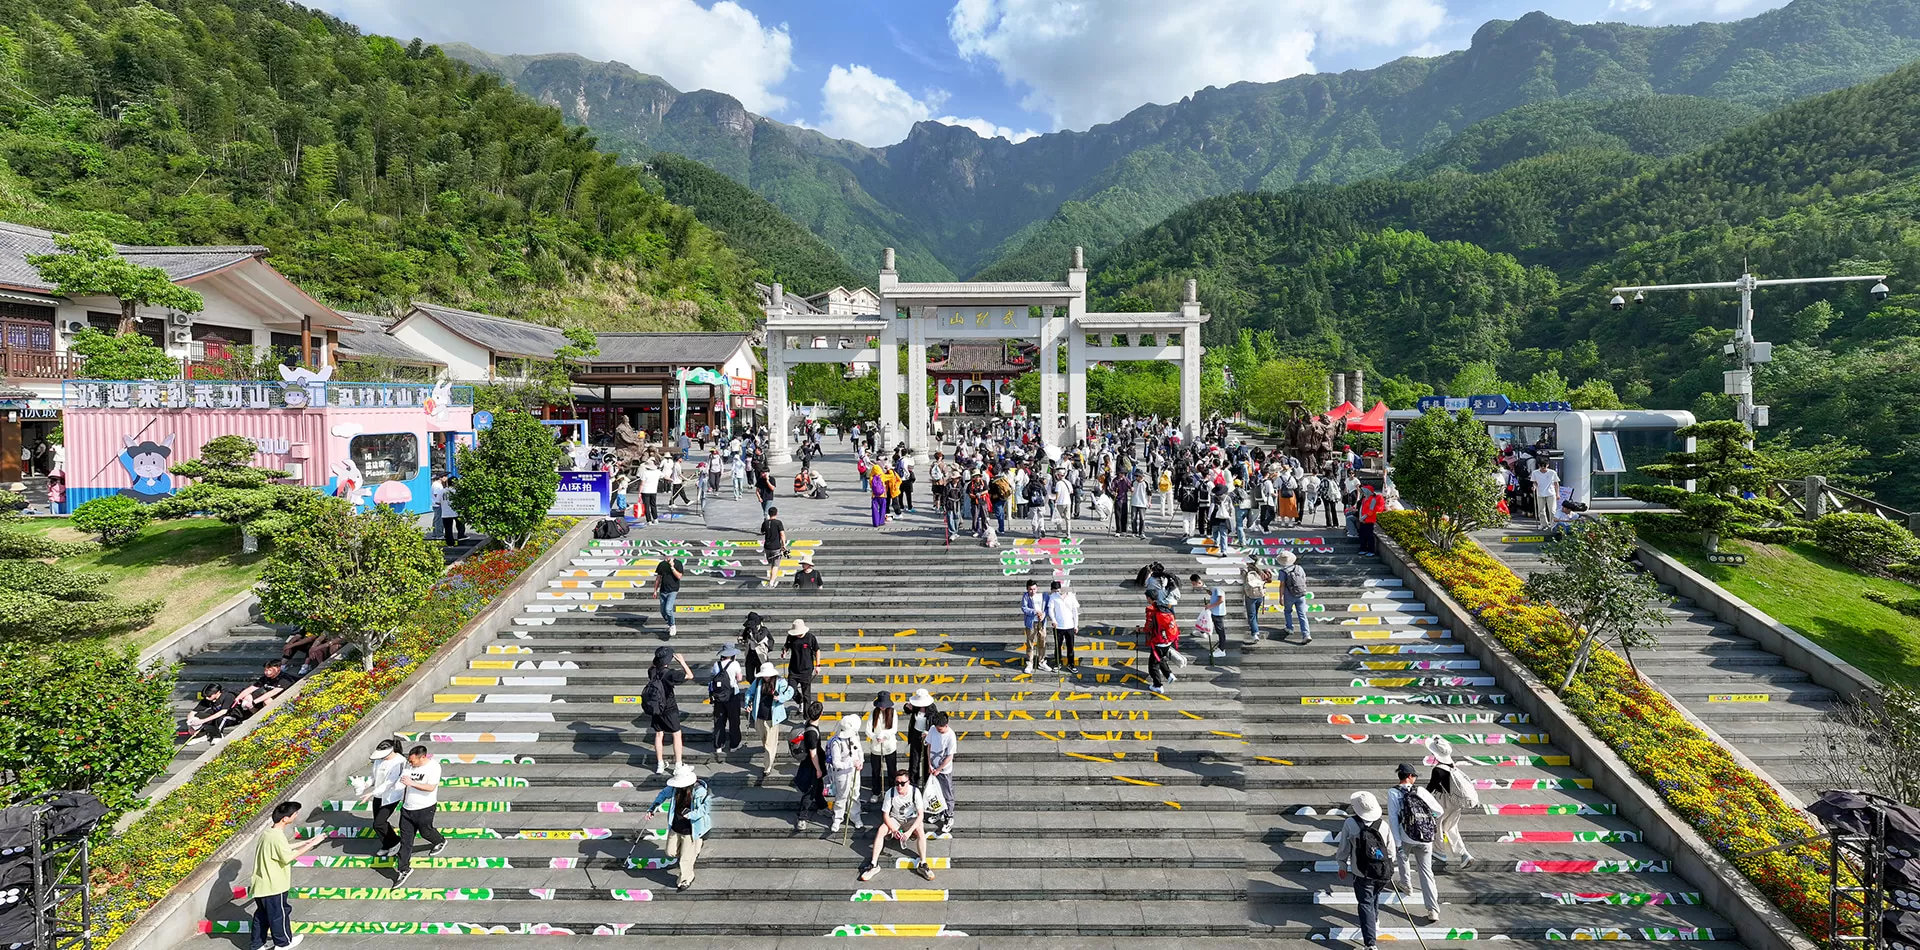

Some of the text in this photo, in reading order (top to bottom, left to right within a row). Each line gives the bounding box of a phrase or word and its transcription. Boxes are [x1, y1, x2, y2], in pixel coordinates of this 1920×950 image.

[949, 309, 1018, 329] 武功山
[78, 383, 270, 408] 欢迎来到武功山
[246, 437, 289, 454] 功山
